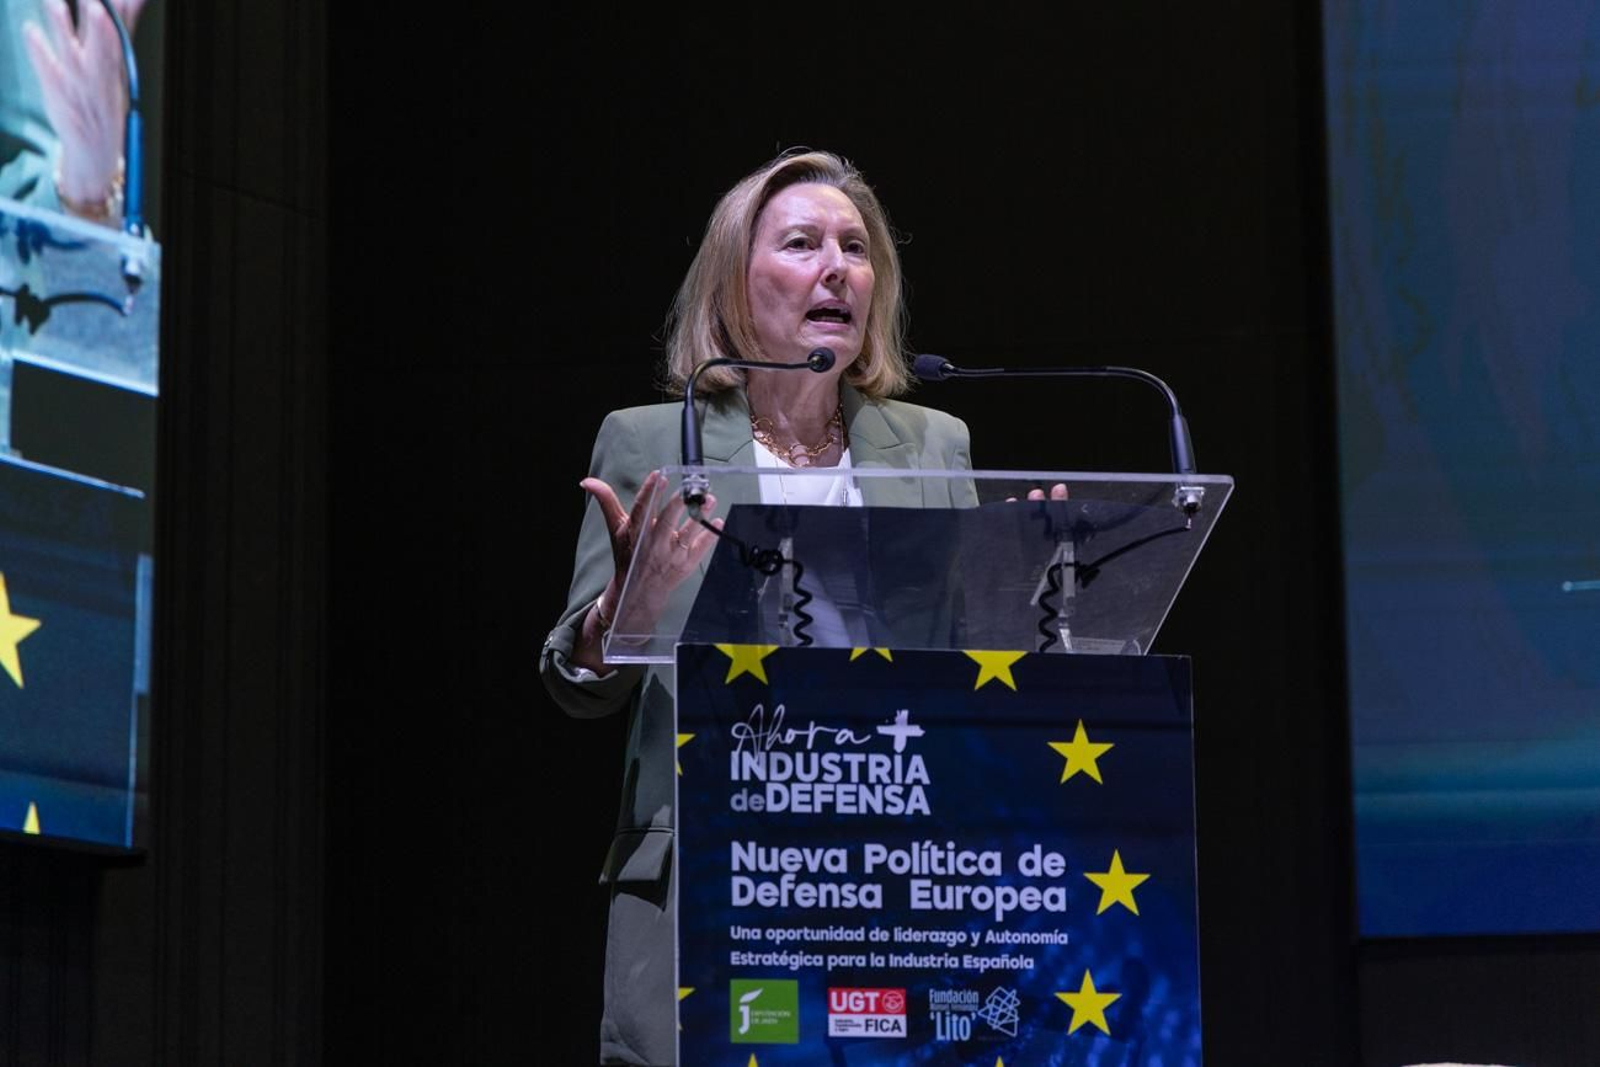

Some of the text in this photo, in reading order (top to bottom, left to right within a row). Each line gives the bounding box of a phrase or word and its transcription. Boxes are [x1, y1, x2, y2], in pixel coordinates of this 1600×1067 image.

[731, 704, 871, 757] Ahora
[730, 751, 931, 785] INDUSTRIA
[730, 840, 1067, 878] Nueva Política de
[730, 874, 1067, 922] Defensa Europea
[730, 925, 1069, 947] Una oportunidad de liderazgo y Autonomía
[730, 951, 1035, 973] Estratégica para la Industria Española
[830, 991, 880, 1012] UGT
[929, 988, 979, 1004] Fundación
[864, 1018, 903, 1033] FICA
